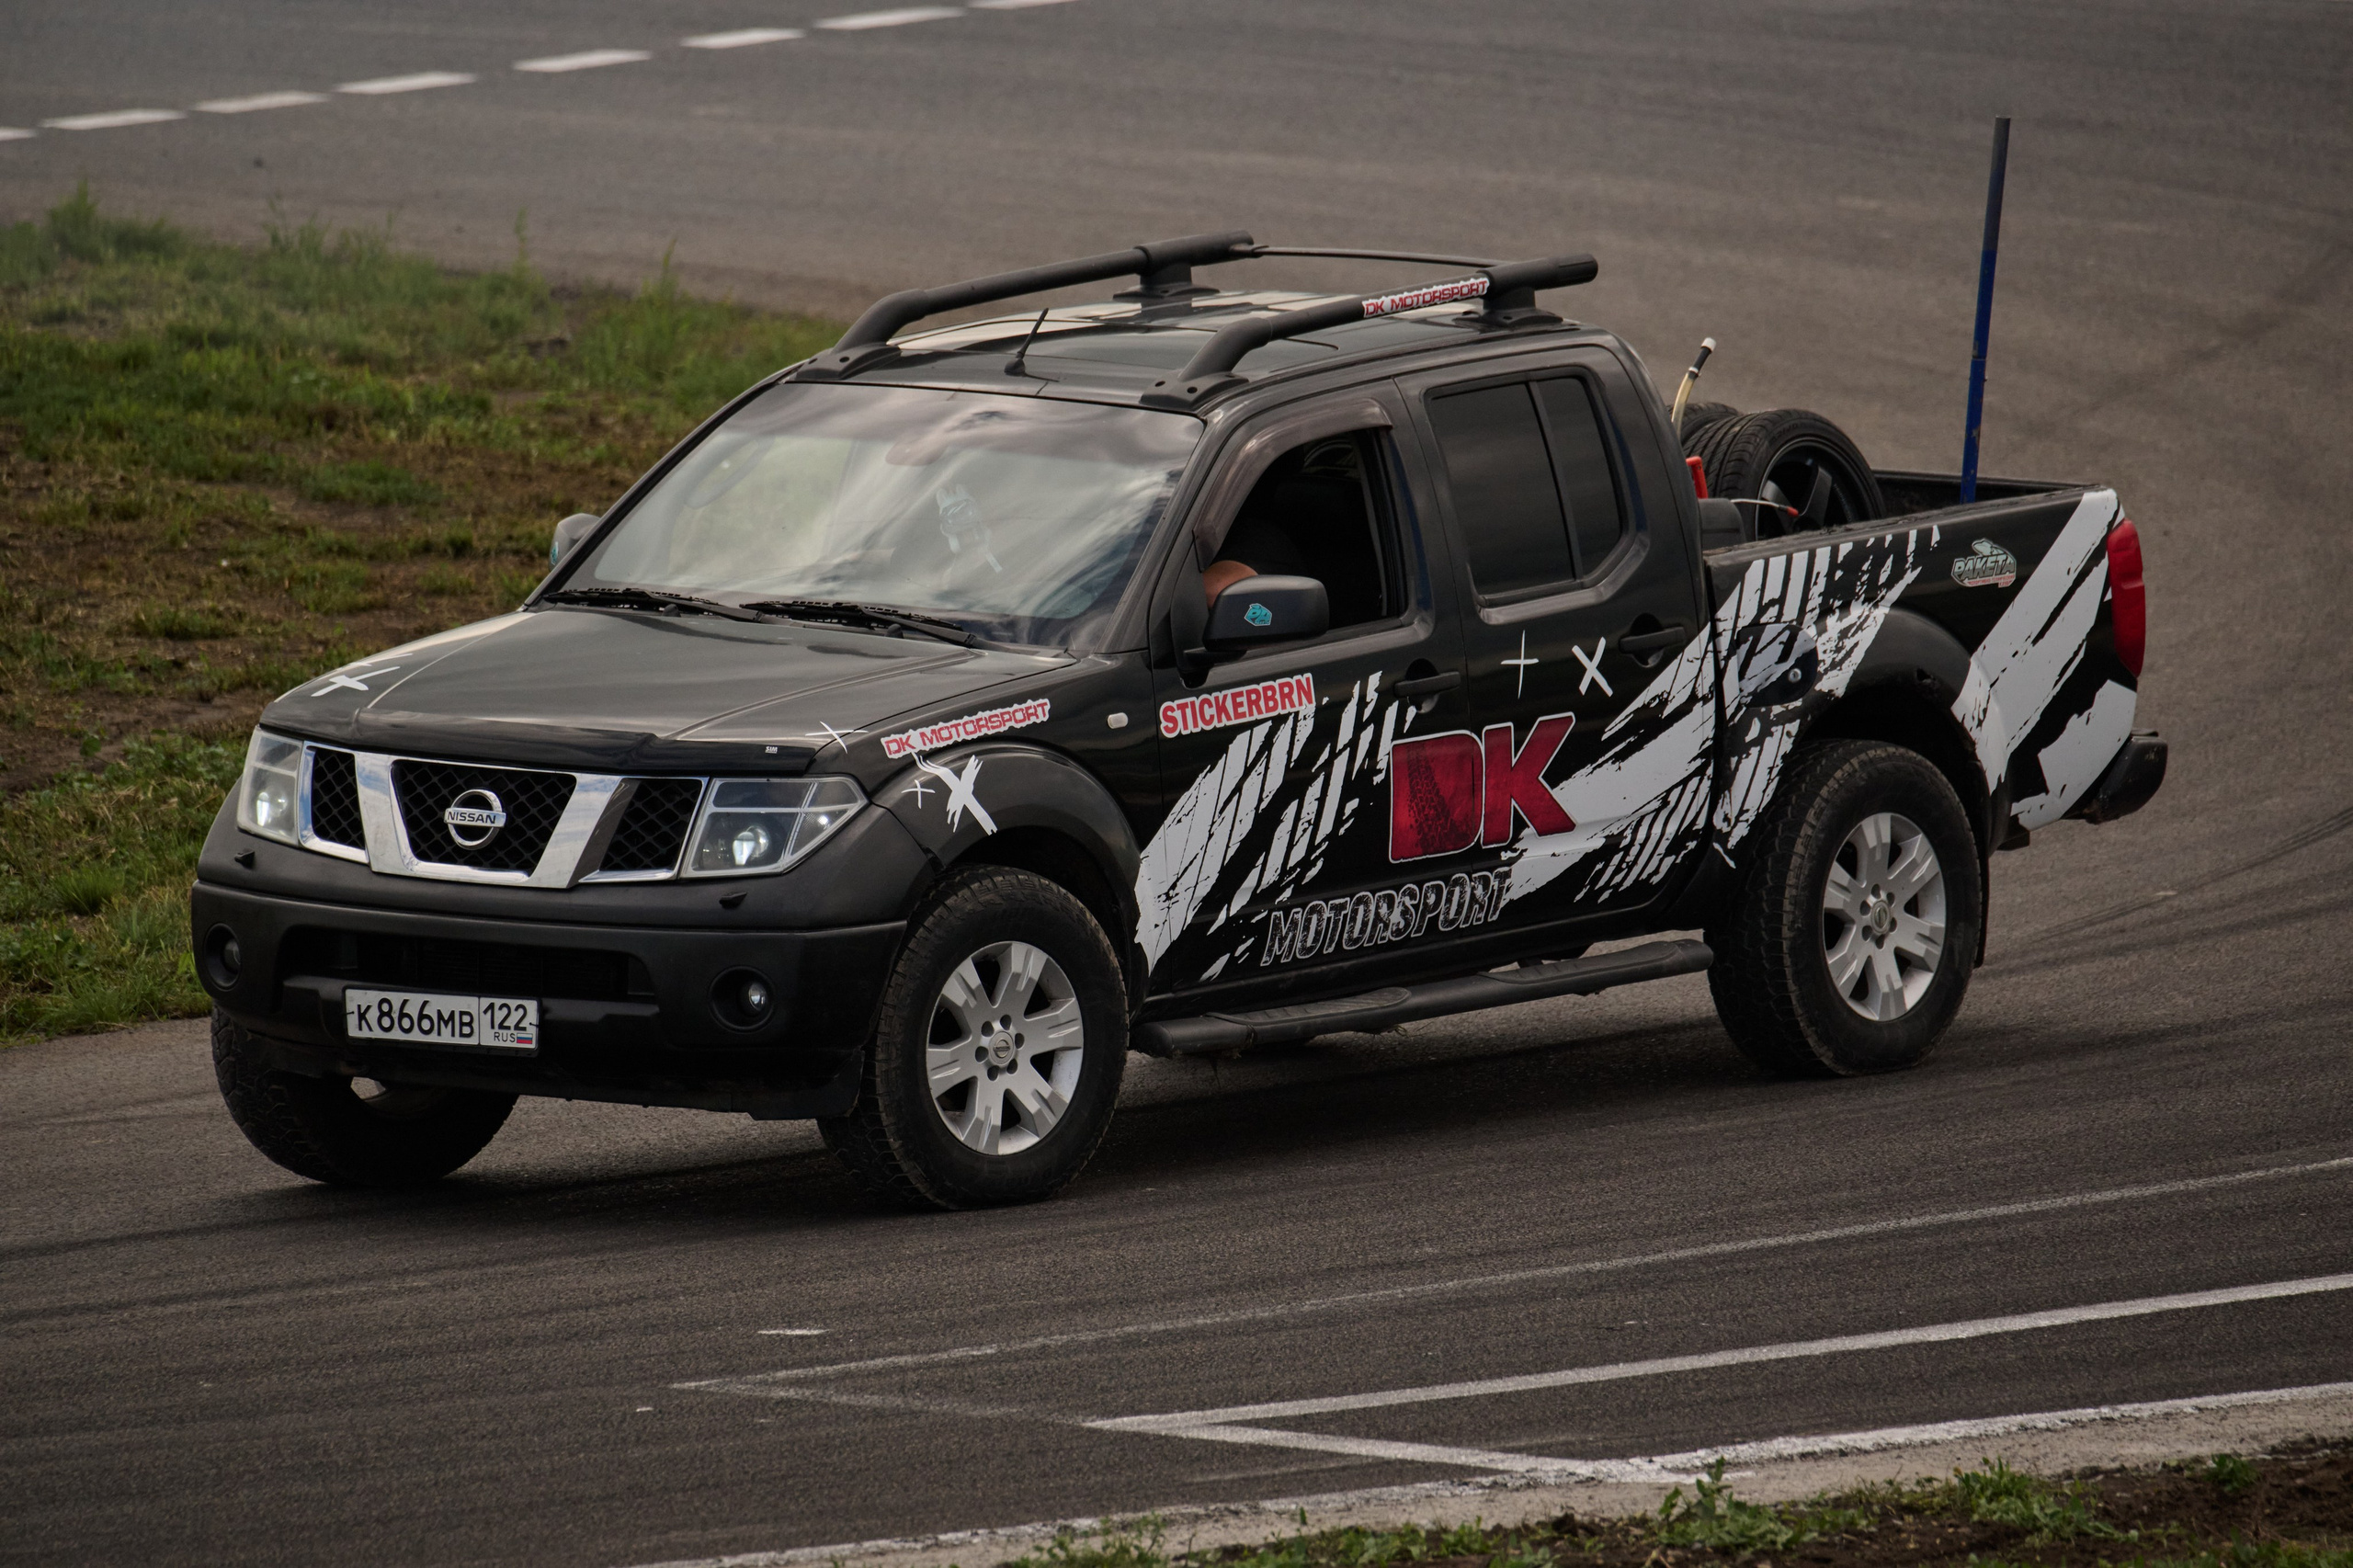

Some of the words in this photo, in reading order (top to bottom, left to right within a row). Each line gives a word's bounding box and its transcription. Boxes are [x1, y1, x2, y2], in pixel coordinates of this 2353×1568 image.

[1365, 301, 1384, 316] DK
[1390, 280, 1488, 311] MOTORSPORT
[1161, 676, 1314, 734] STICKERBRN
[884, 734, 916, 756] DK
[919, 701, 1049, 746] MOTORSPORT
[1390, 711, 1576, 863] DK
[447, 811, 496, 824] NISSAN
[1260, 867, 1512, 967] MOTORSPORT
[483, 1002, 528, 1032] 122
[494, 1031, 516, 1043] RUS
